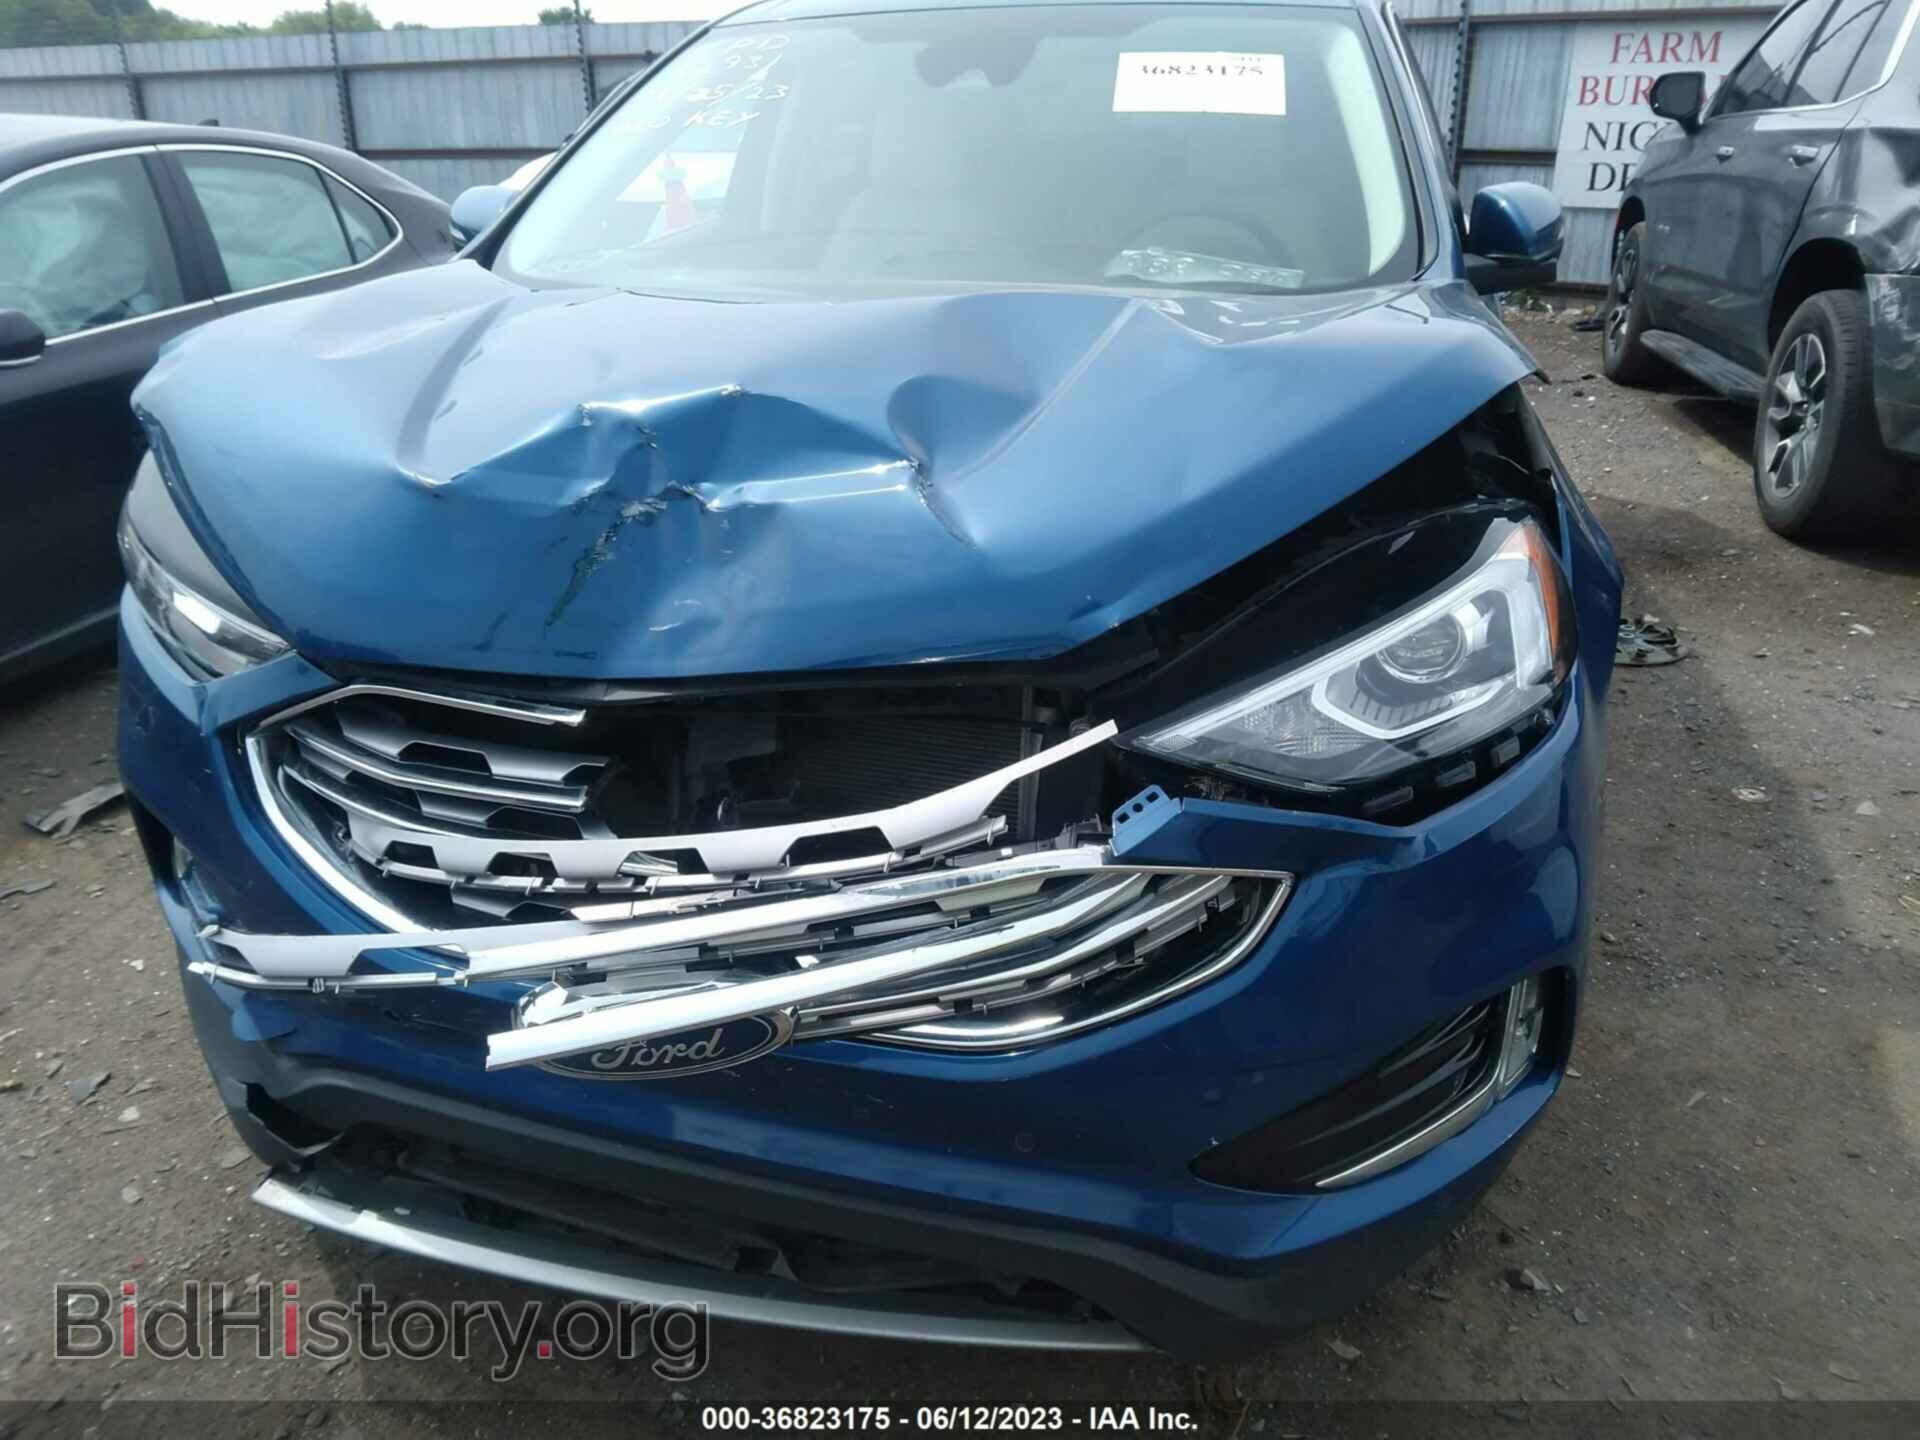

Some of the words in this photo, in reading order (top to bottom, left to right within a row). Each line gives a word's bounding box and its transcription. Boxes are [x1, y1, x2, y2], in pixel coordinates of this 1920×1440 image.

[1609, 31, 1723, 64] FARM
[1581, 121, 1673, 151] NIC
[591, 1028, 724, 1070] Ford
